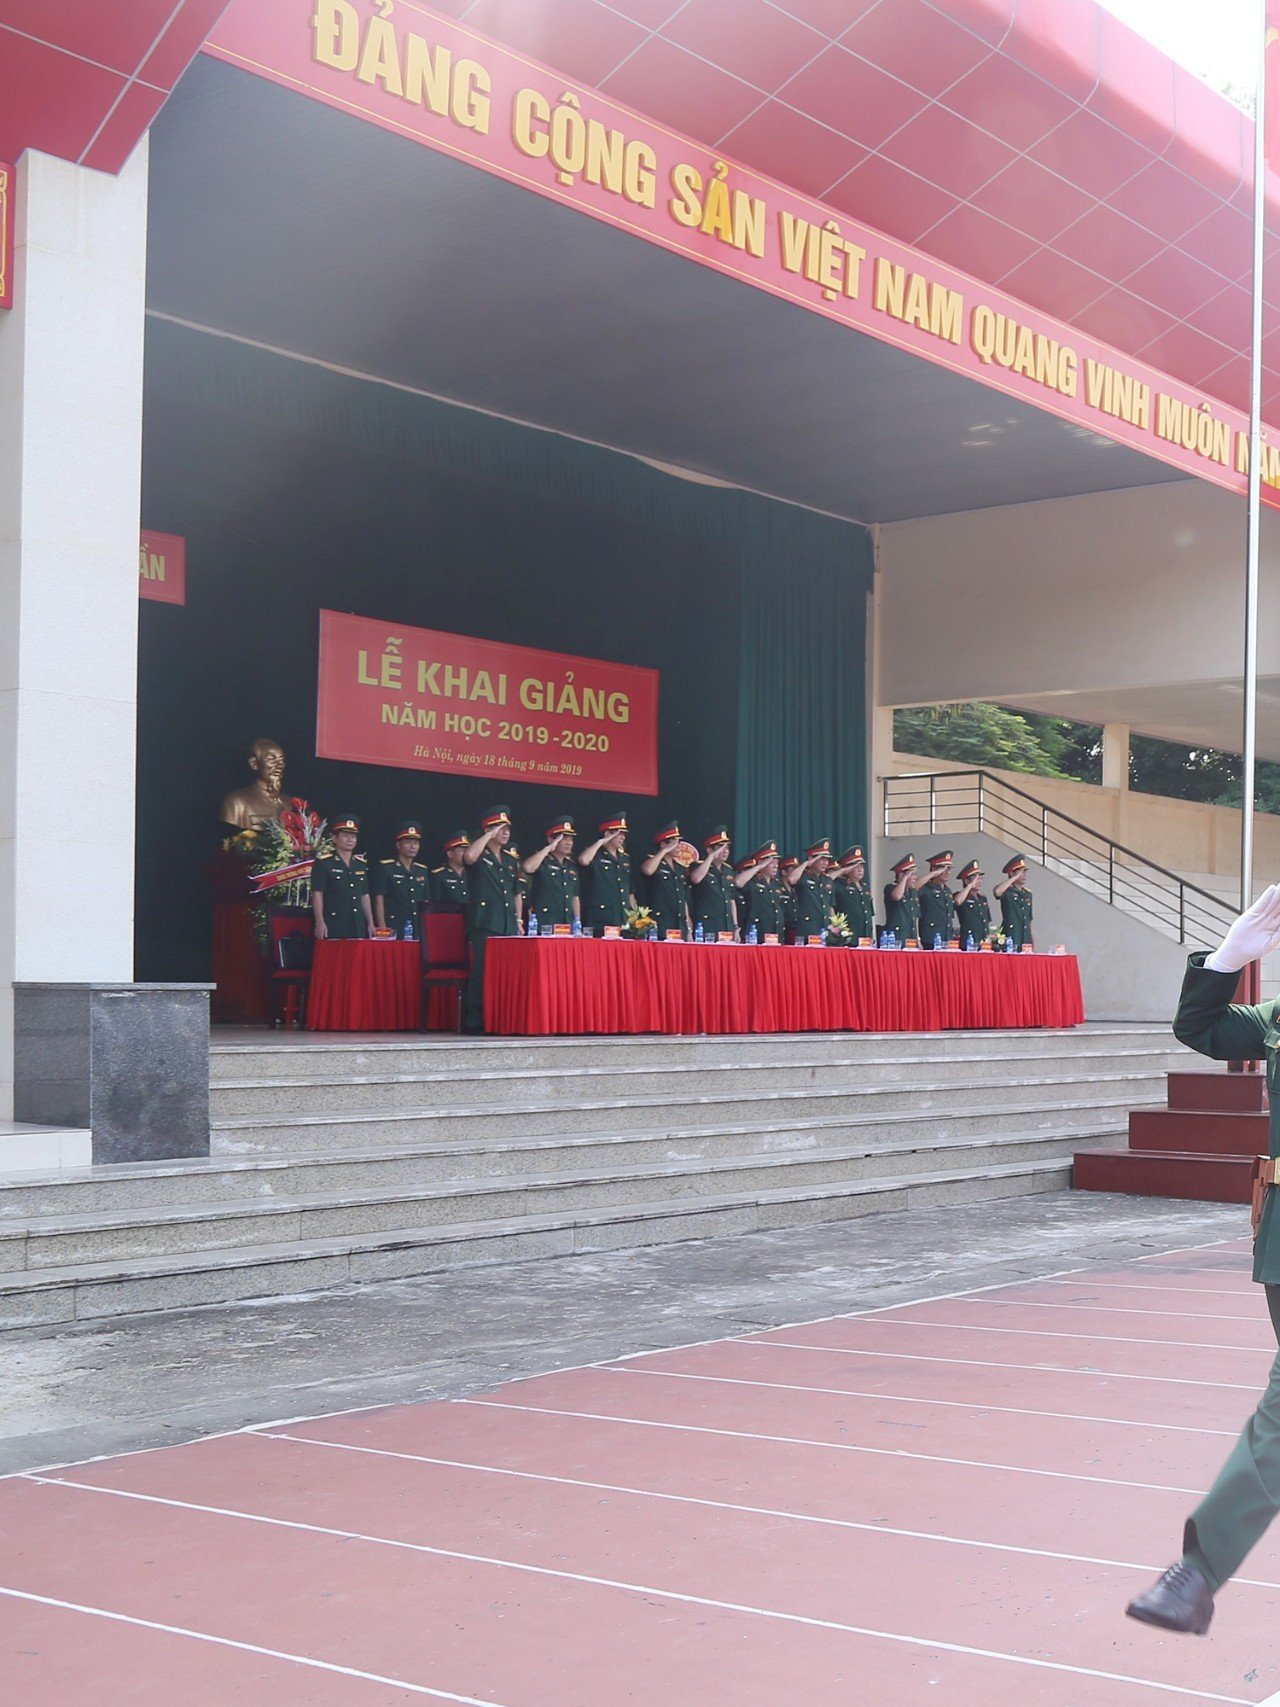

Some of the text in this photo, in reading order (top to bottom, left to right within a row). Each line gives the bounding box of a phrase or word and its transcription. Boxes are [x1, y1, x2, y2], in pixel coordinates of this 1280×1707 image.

[313, 0, 491, 135] ĐẢNG
[511, 91, 657, 209] CỘNG
[670, 160, 766, 258] SẢN
[778, 220, 866, 301] VIỆT
[872, 256, 964, 345] NAM
[970, 304, 1077, 397] QUANG
[1084, 358, 1150, 429] VINH
[1155, 402, 1230, 466] MUÔN
[357, 637, 630, 723] LỄ KHAI GIẢNG
[381, 702, 437, 730] NĂM
[445, 713, 492, 741] HỌC
[414, 745, 582, 775] Hà Nội, ngày 18 tháng 9 năm 2019
